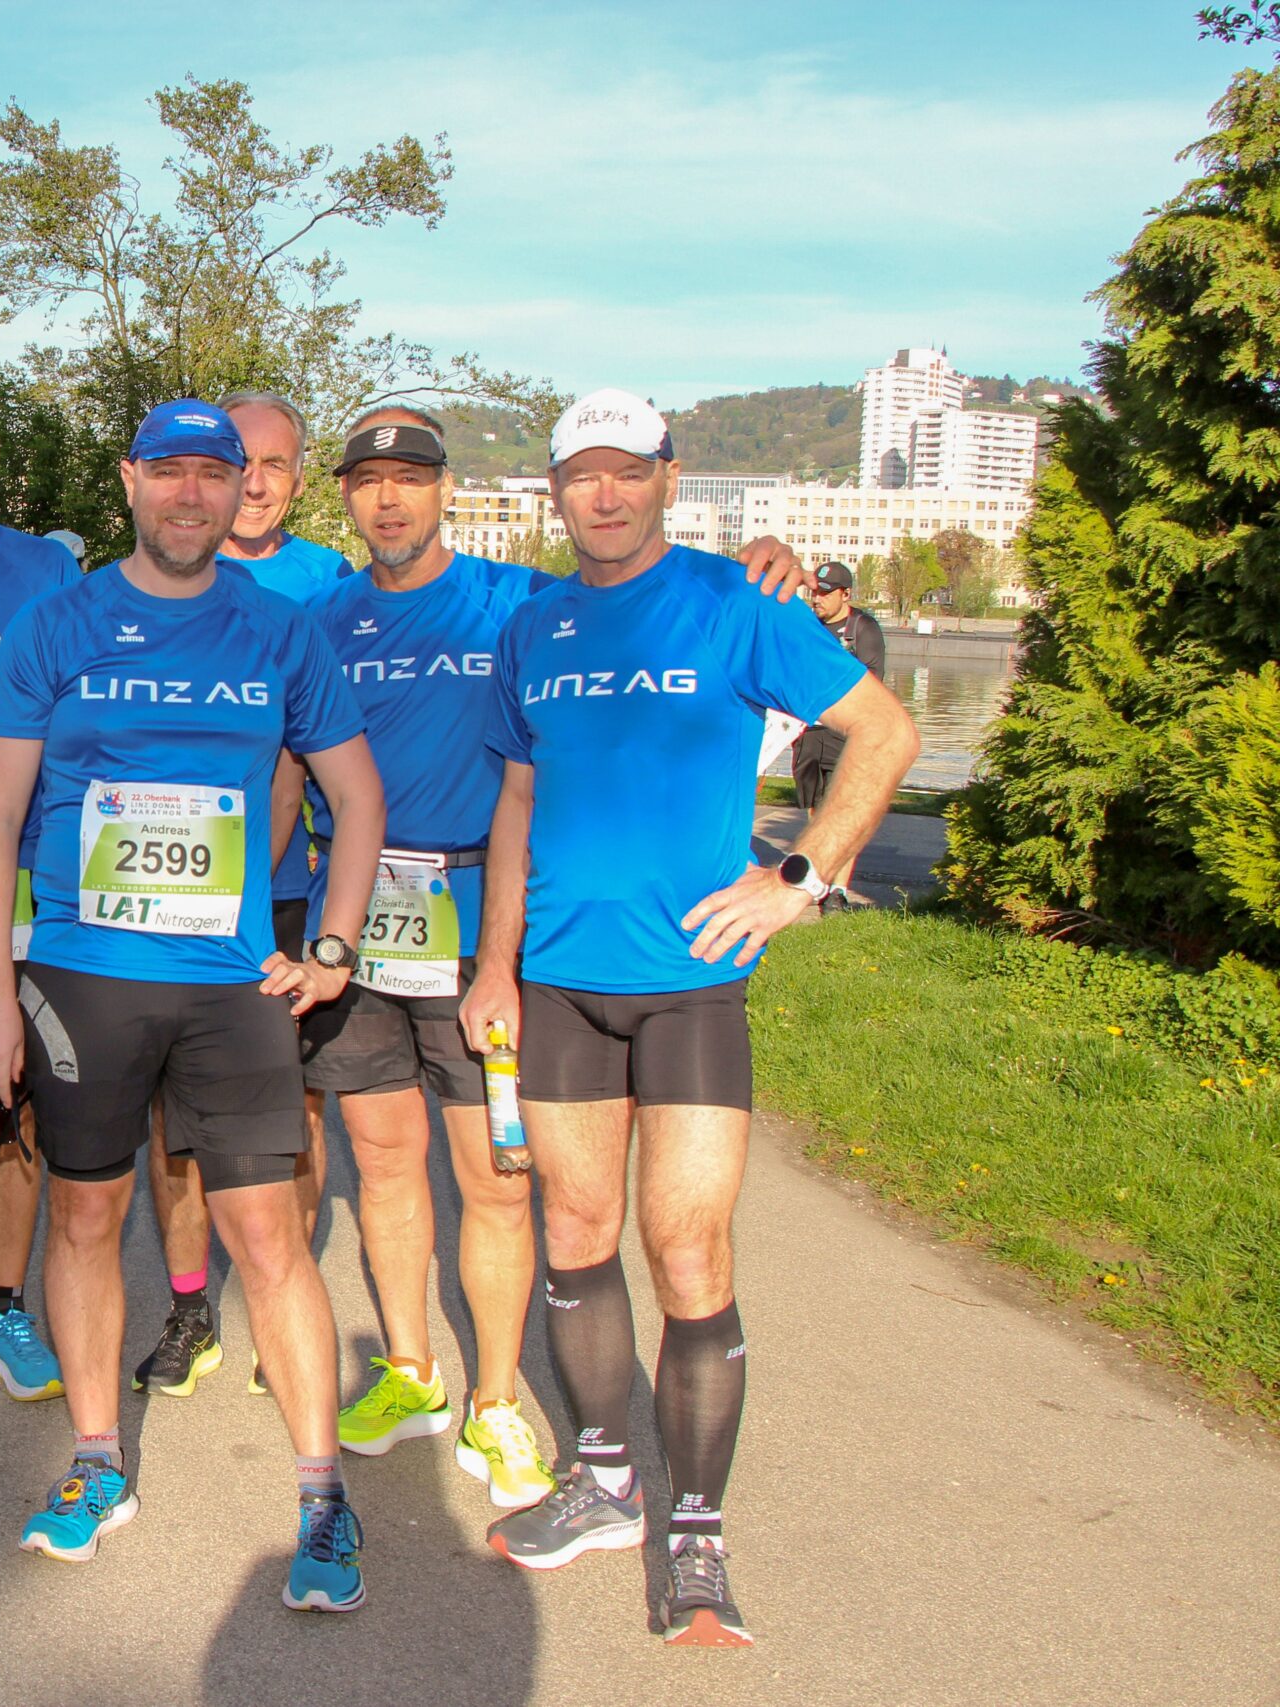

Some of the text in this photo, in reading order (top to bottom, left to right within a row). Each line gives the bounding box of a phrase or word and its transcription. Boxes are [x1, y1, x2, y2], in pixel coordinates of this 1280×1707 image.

[116, 635, 145, 643] erima
[342, 653, 493, 684] NZ AG
[80, 675, 268, 706] LINZ AG
[524, 669, 698, 706] LINZ AG
[144, 794, 181, 802] Oberbank
[141, 824, 191, 836] Andreas
[115, 840, 211, 878] 2599
[161, 886, 231, 894] HALBMARATHON
[96, 894, 222, 931] LAT Nitrogen
[374, 899, 415, 910] Christian
[379, 973, 441, 993] Nitrogen
